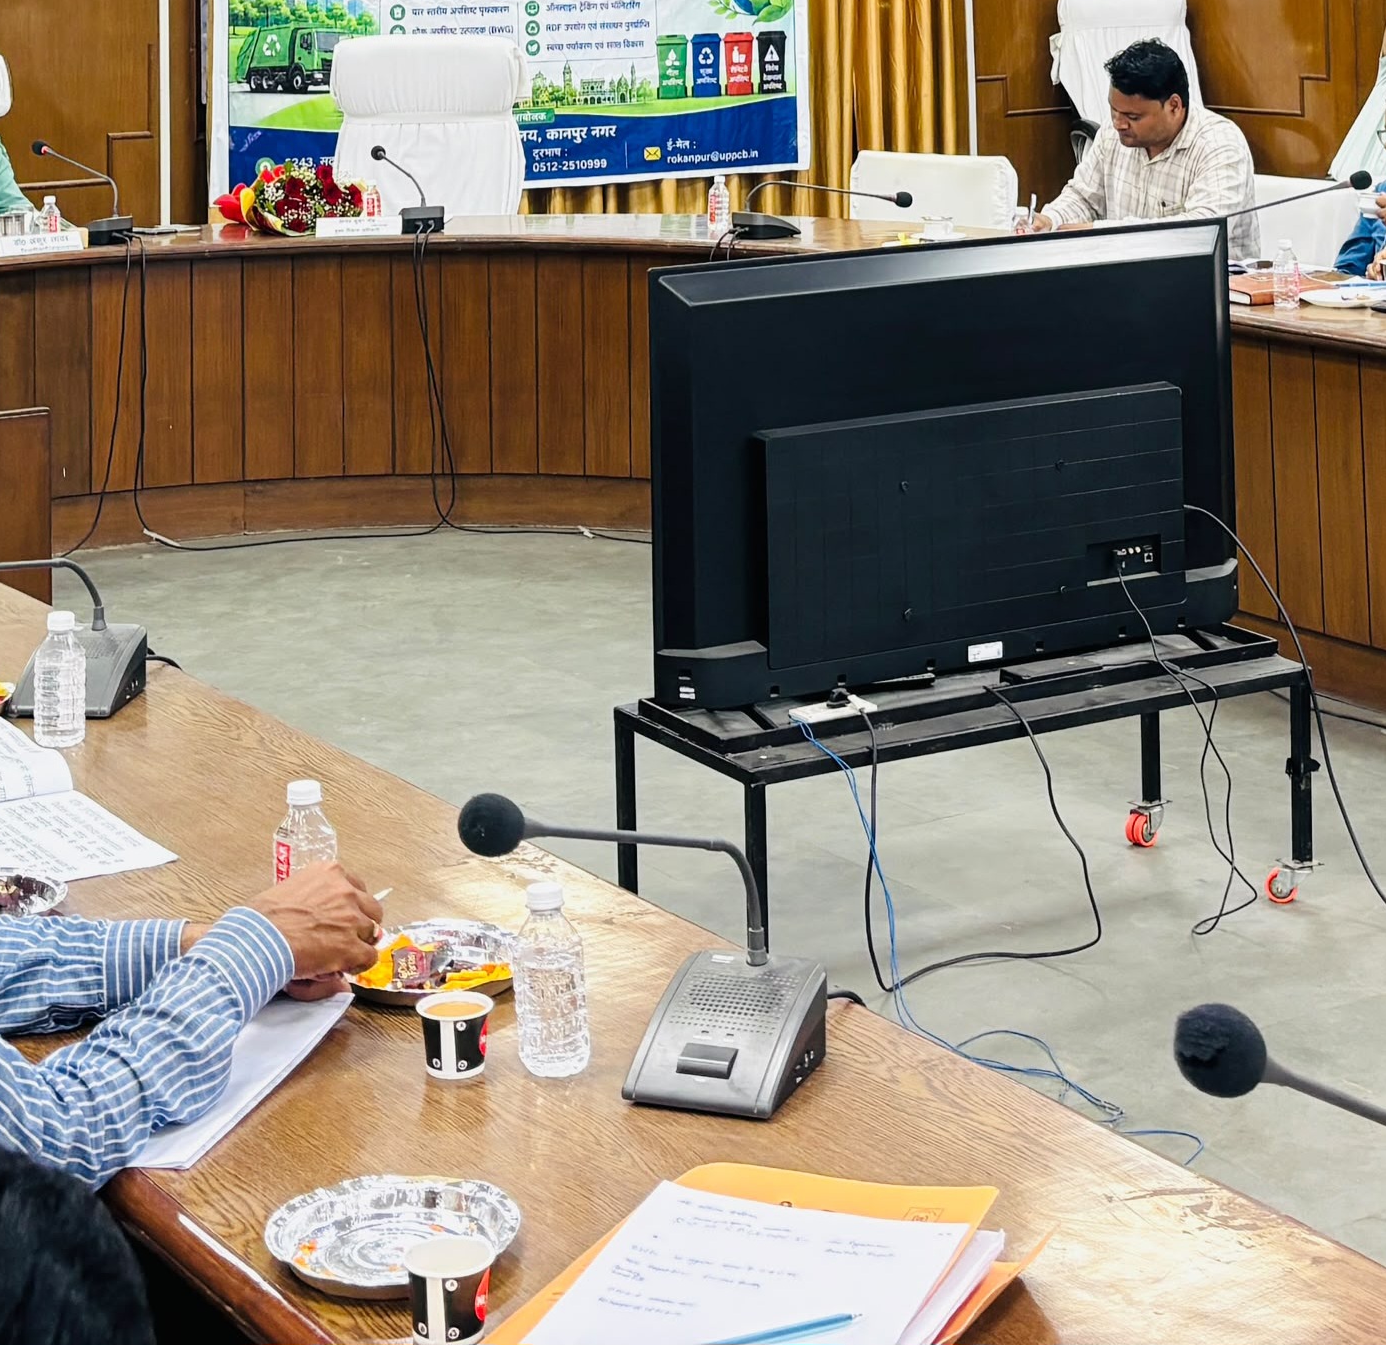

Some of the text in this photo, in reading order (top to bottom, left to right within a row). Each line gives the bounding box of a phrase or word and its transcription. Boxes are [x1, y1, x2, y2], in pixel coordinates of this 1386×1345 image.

[546, 127, 588, 143] कानपुर
[591, 125, 617, 139] नगर
[667, 149, 759, 164] rokanpur@uppcb.in
[532, 159, 608, 173] 0512-2510999
